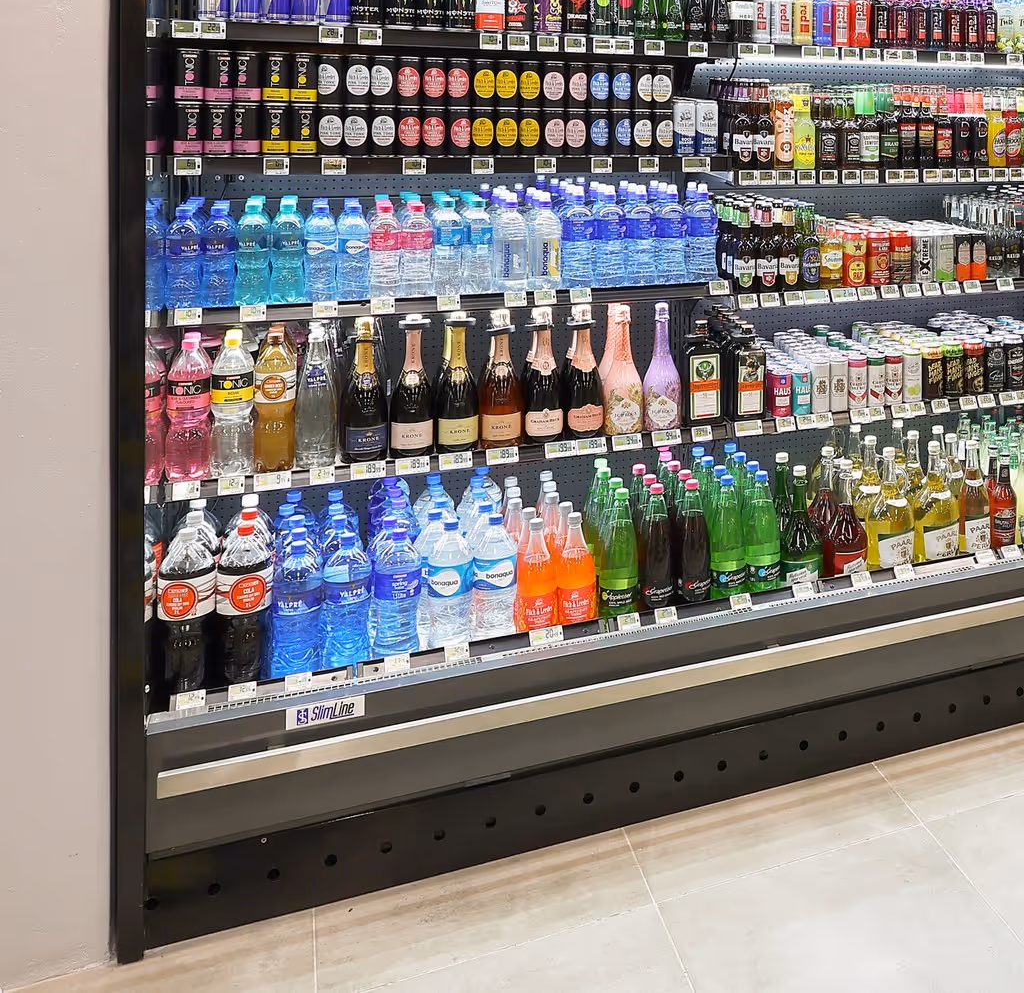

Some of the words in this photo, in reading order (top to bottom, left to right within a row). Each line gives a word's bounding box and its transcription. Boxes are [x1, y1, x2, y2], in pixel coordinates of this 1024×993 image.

[502, 242, 510, 278] bonaqua
[541, 242, 549, 276] bonaqua
[218, 379, 249, 389] TONIC
[171, 385, 201, 396] TONIC
[485, 570, 514, 580] bonaqua
[430, 578, 459, 587] bonaqua
[311, 700, 355, 721] SlimLine
